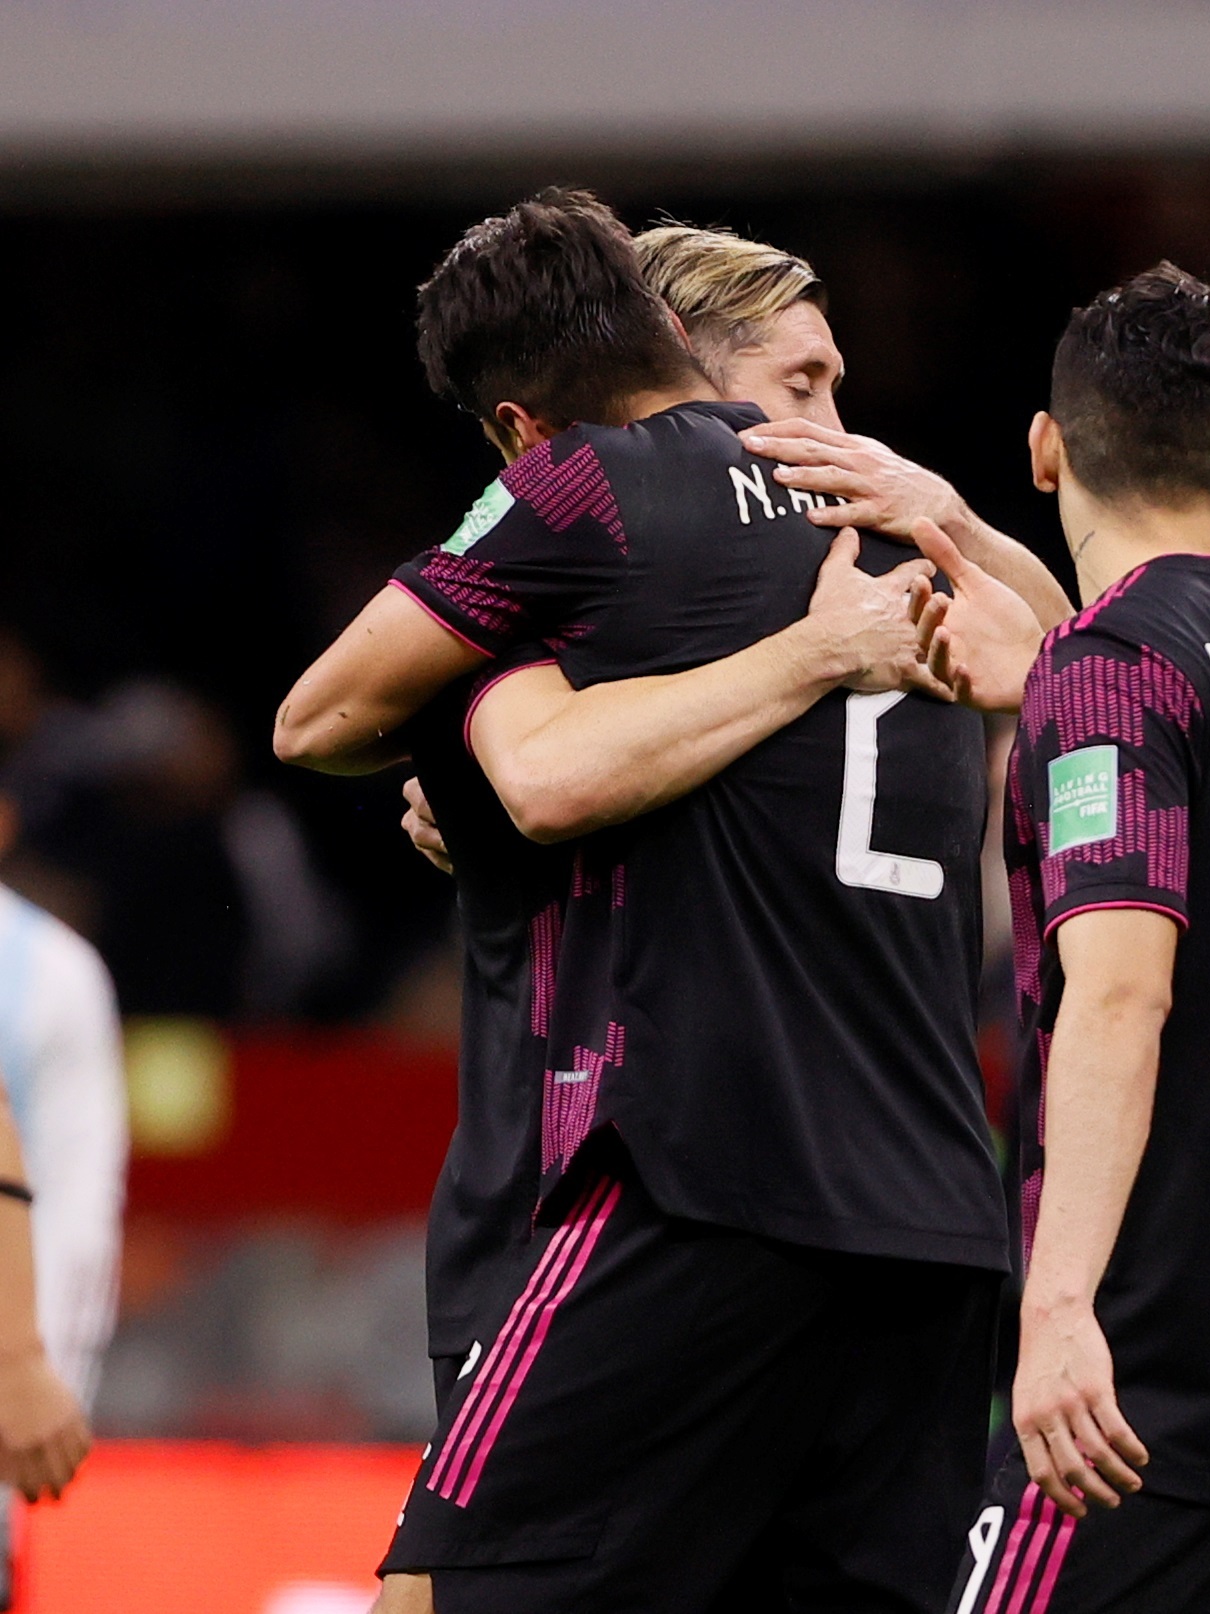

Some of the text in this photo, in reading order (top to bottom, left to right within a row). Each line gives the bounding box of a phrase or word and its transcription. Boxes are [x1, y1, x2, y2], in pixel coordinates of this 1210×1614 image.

[1053, 771, 1109, 797] LIVING
[1053, 782, 1108, 805] FOOTBALL
[1079, 801, 1109, 819] FIFA
